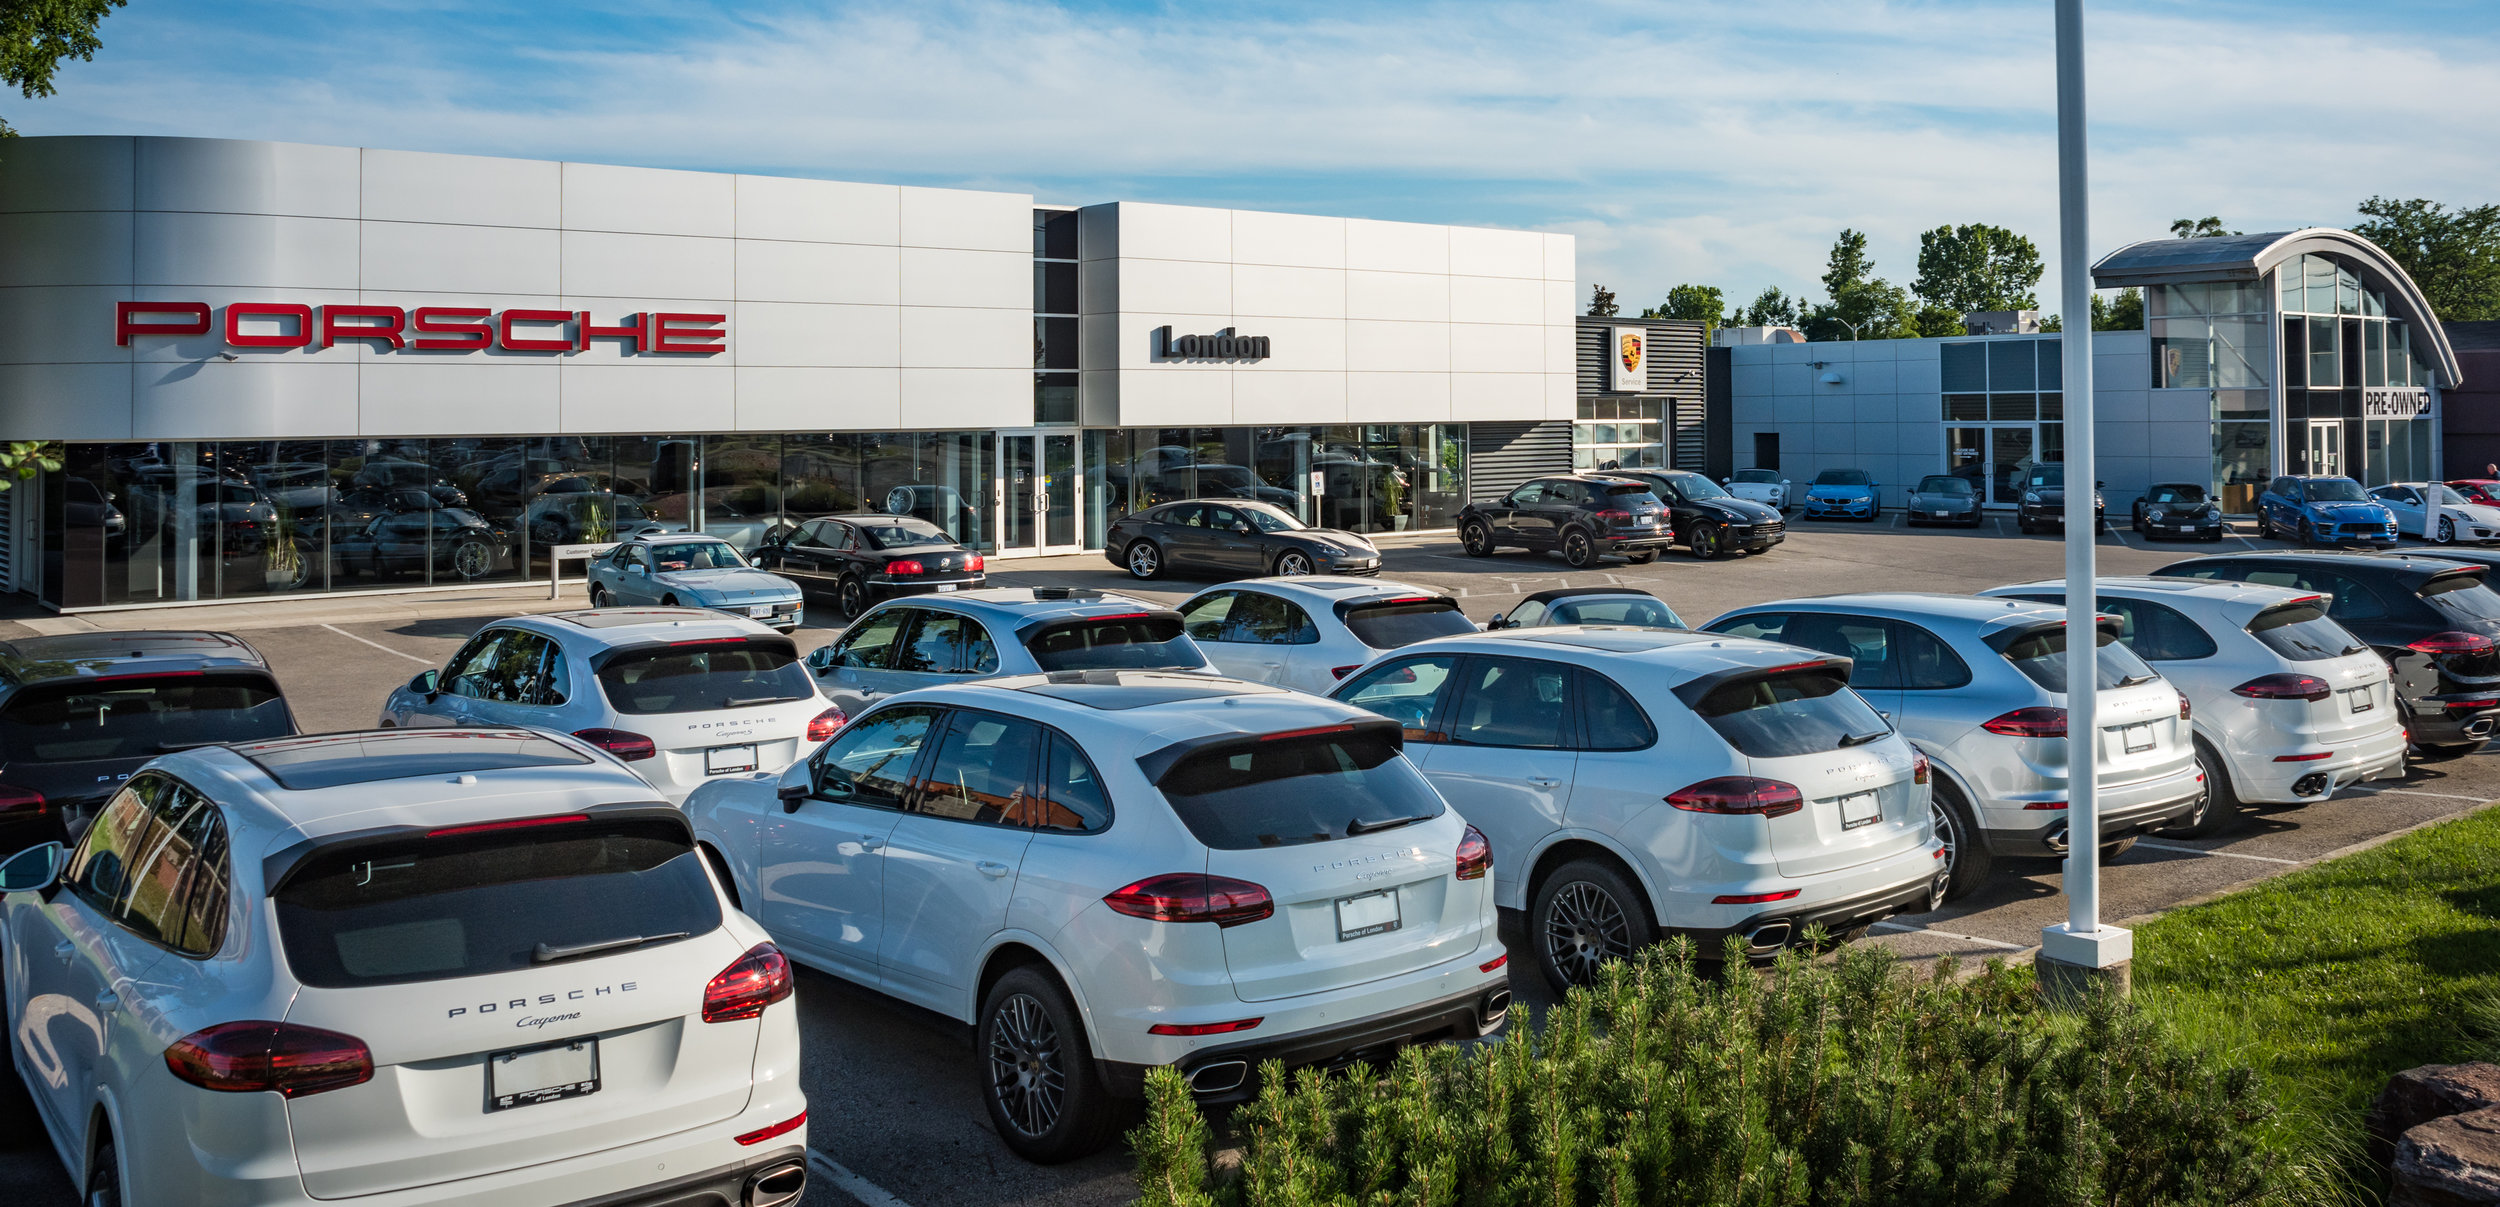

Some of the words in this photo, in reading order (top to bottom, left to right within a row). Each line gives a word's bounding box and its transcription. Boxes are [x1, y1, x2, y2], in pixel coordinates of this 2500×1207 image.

[115, 301, 726, 352] PORSCHE
[1161, 325, 1271, 358] London
[1621, 378, 1641, 386] Service
[2365, 391, 2431, 415] PRE-OWNED
[689, 717, 776, 730] PORSCHE
[1342, 929, 1361, 939] Porsche
[1367, 925, 1384, 934] London
[448, 981, 638, 1018] PORSCHE
[516, 1011, 582, 1029] Cayenne
[519, 1083, 576, 1099] PORSCHE
